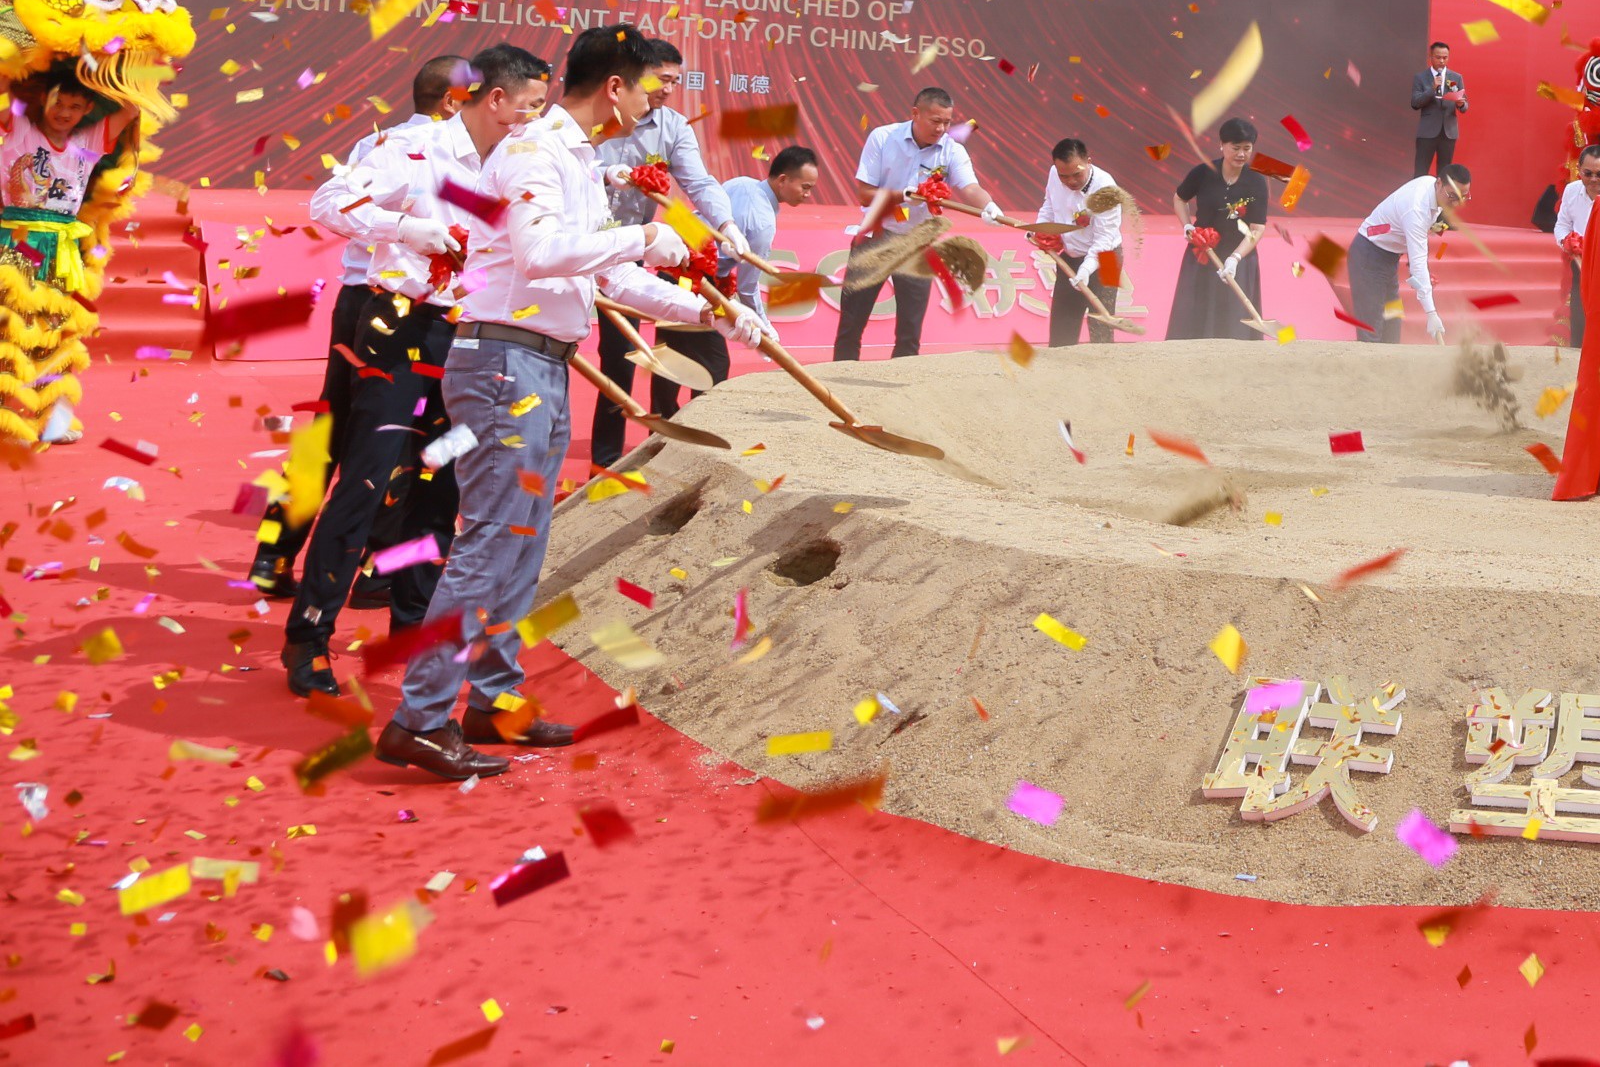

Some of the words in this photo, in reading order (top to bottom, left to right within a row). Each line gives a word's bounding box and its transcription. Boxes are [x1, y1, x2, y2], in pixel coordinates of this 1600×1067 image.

[867, 0, 904, 22] OF
[619, 11, 757, 42] FACTORY
[764, 22, 802, 46] OF
[808, 26, 898, 53] CHINA
[903, 35, 986, 60] LESSO
